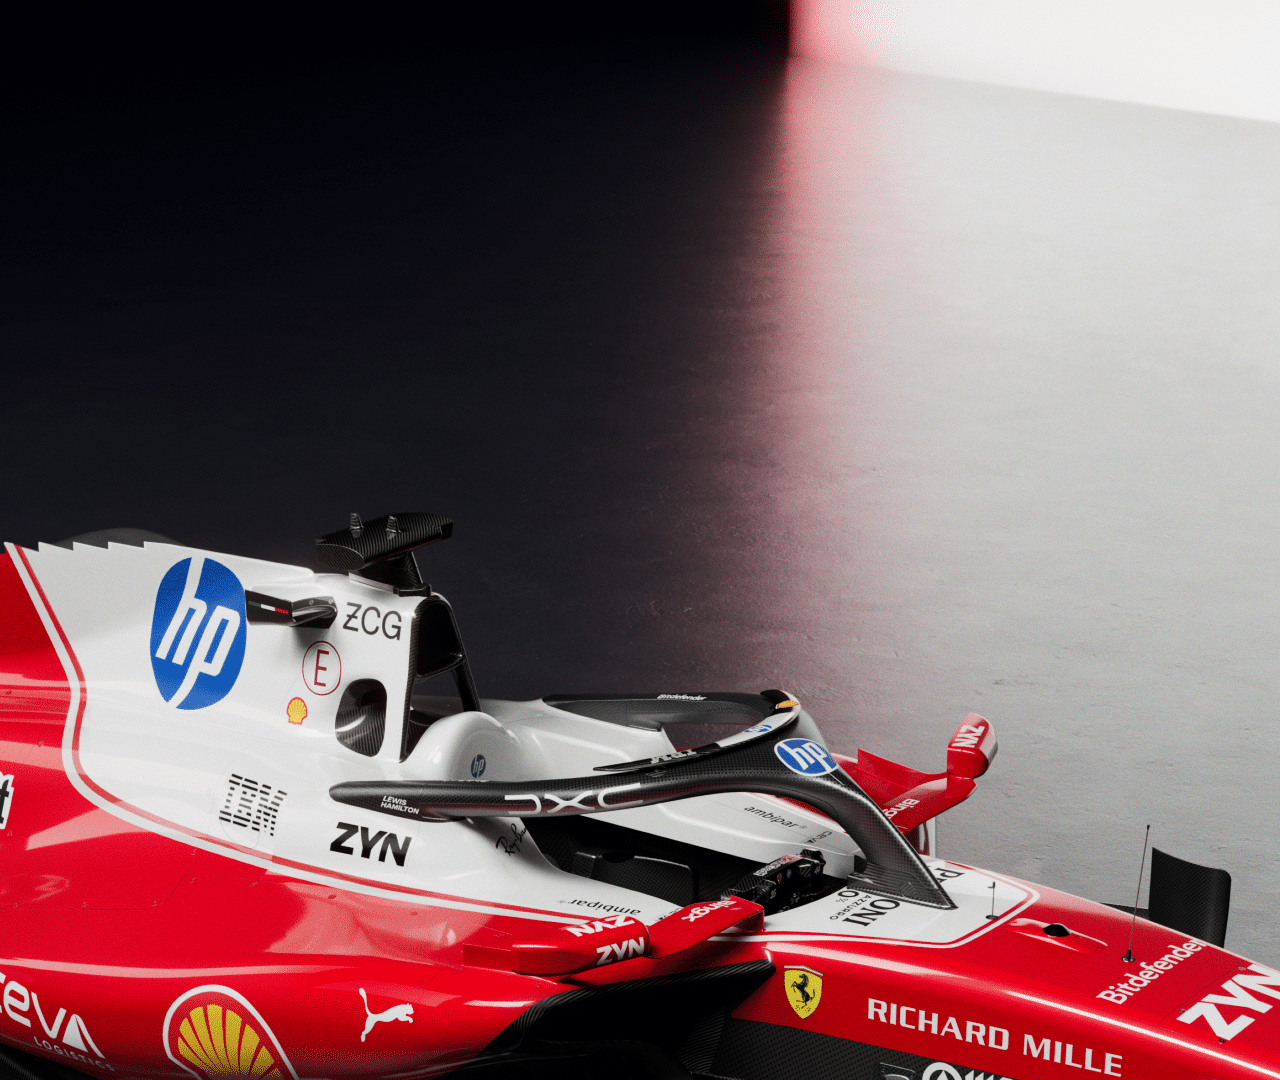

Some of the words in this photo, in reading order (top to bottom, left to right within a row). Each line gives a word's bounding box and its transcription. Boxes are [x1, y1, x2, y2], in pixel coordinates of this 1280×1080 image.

[152, 556, 245, 710] hp
[342, 601, 402, 641] ZCG
[313, 648, 330, 687] E
[951, 724, 986, 749] ZYN
[775, 737, 838, 777] hp
[219, 773, 288, 837] IBM
[380, 801, 420, 815] HAMILTON
[382, 795, 408, 806] LEWIS
[504, 782, 645, 814] DXC
[882, 798, 921, 820] Bing
[329, 821, 413, 868] ZYN
[565, 914, 636, 937] ZYN
[596, 936, 645, 966] ZYN
[1096, 937, 1208, 1005] Bitdefender
[33, 1035, 116, 1072] LOGISTICS
[866, 997, 1010, 1051] RICHARD
[1022, 1033, 1124, 1078] MILLE
